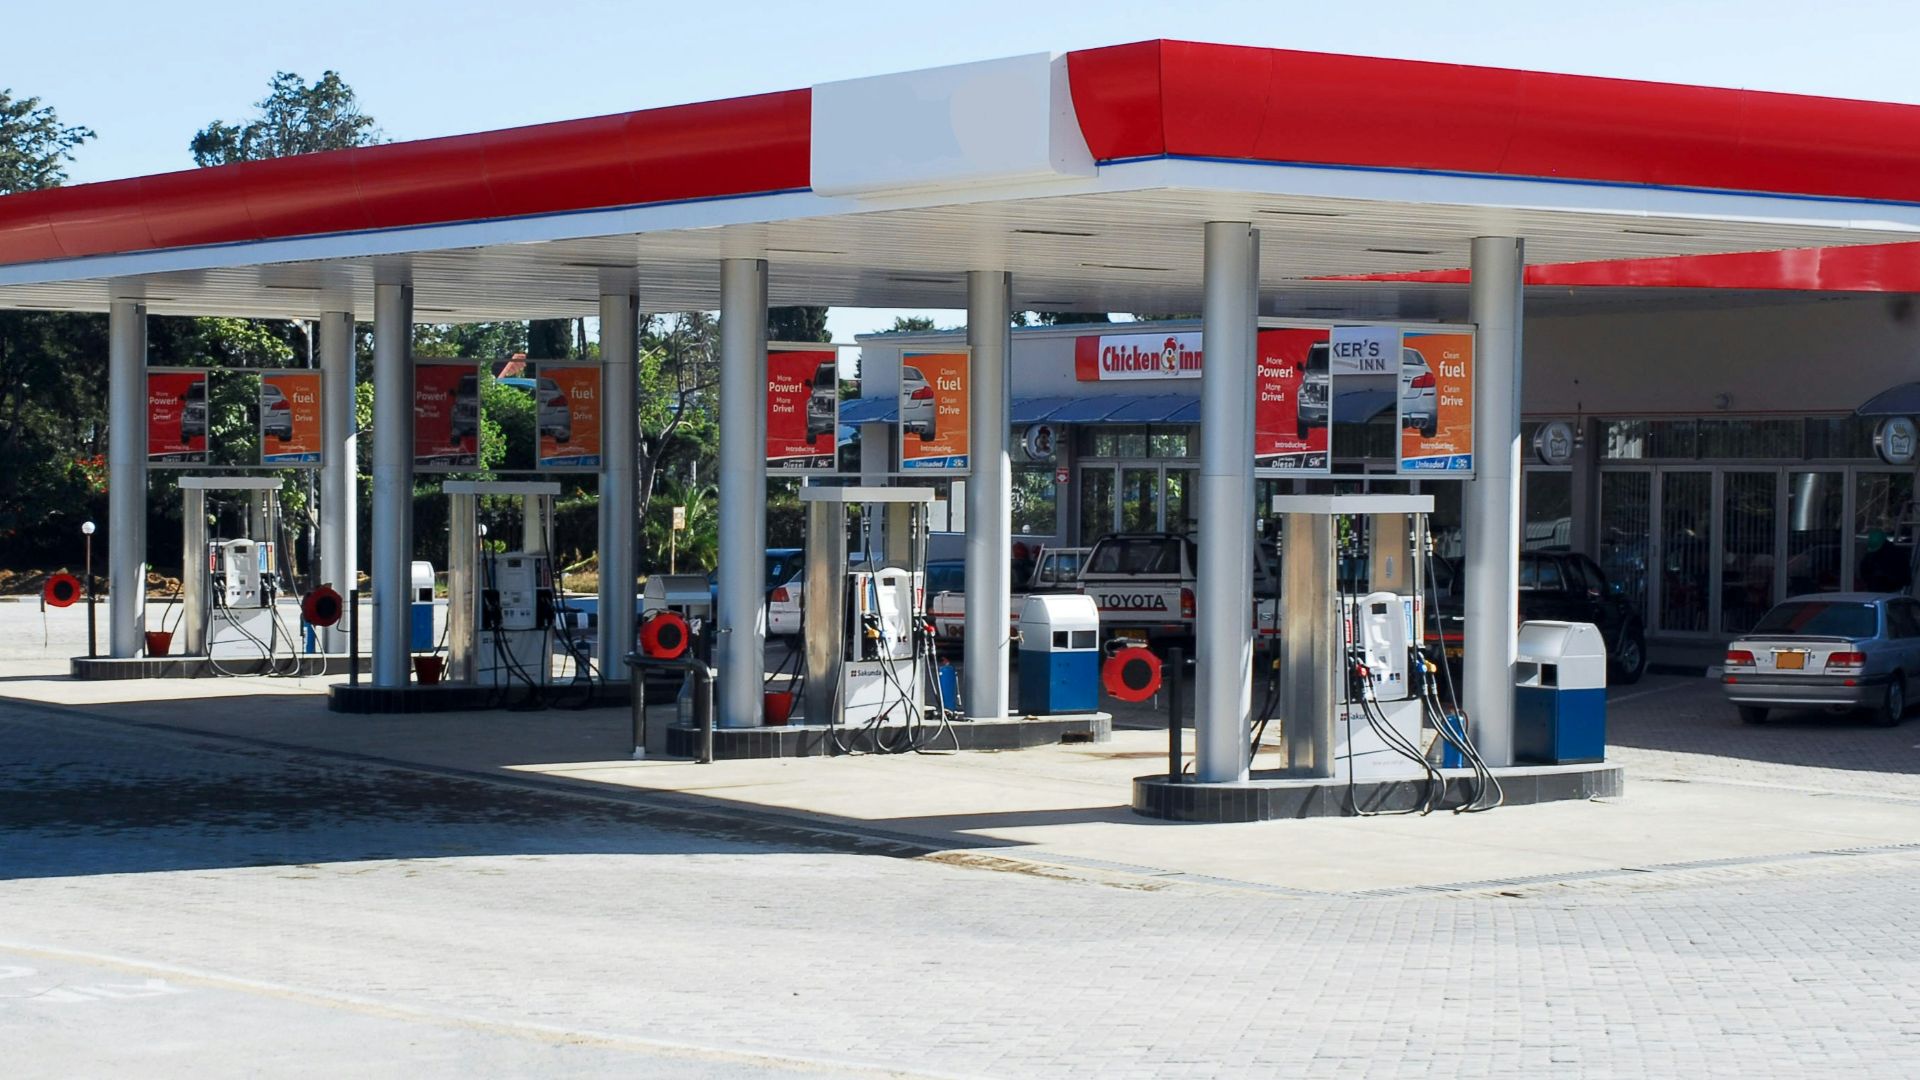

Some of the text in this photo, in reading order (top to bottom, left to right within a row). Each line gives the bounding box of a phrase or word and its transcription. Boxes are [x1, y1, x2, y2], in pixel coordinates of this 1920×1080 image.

[1102, 345, 1160, 372] Chicken
[1266, 356, 1283, 365] More
[1442, 351, 1460, 359] Clean
[1359, 358, 1386, 371] INN
[1438, 360, 1466, 378] fuel
[940, 367, 957, 375] Clean
[1257, 364, 1294, 378] Power!
[776, 374, 792, 382] More
[936, 376, 962, 391] fuel
[768, 381, 802, 393] Power!
[1264, 382, 1281, 391] More
[1443, 385, 1460, 393] Clean
[292, 391, 315, 404] fuel
[571, 386, 594, 400] fuel
[1261, 391, 1285, 402] Drive!
[149, 396, 178, 406] Power!
[775, 396, 791, 404] More
[1440, 395, 1464, 407] Drive
[772, 404, 795, 413] Drive!
[939, 405, 961, 416] Drive
[1098, 594, 1167, 608] TOYOTA
